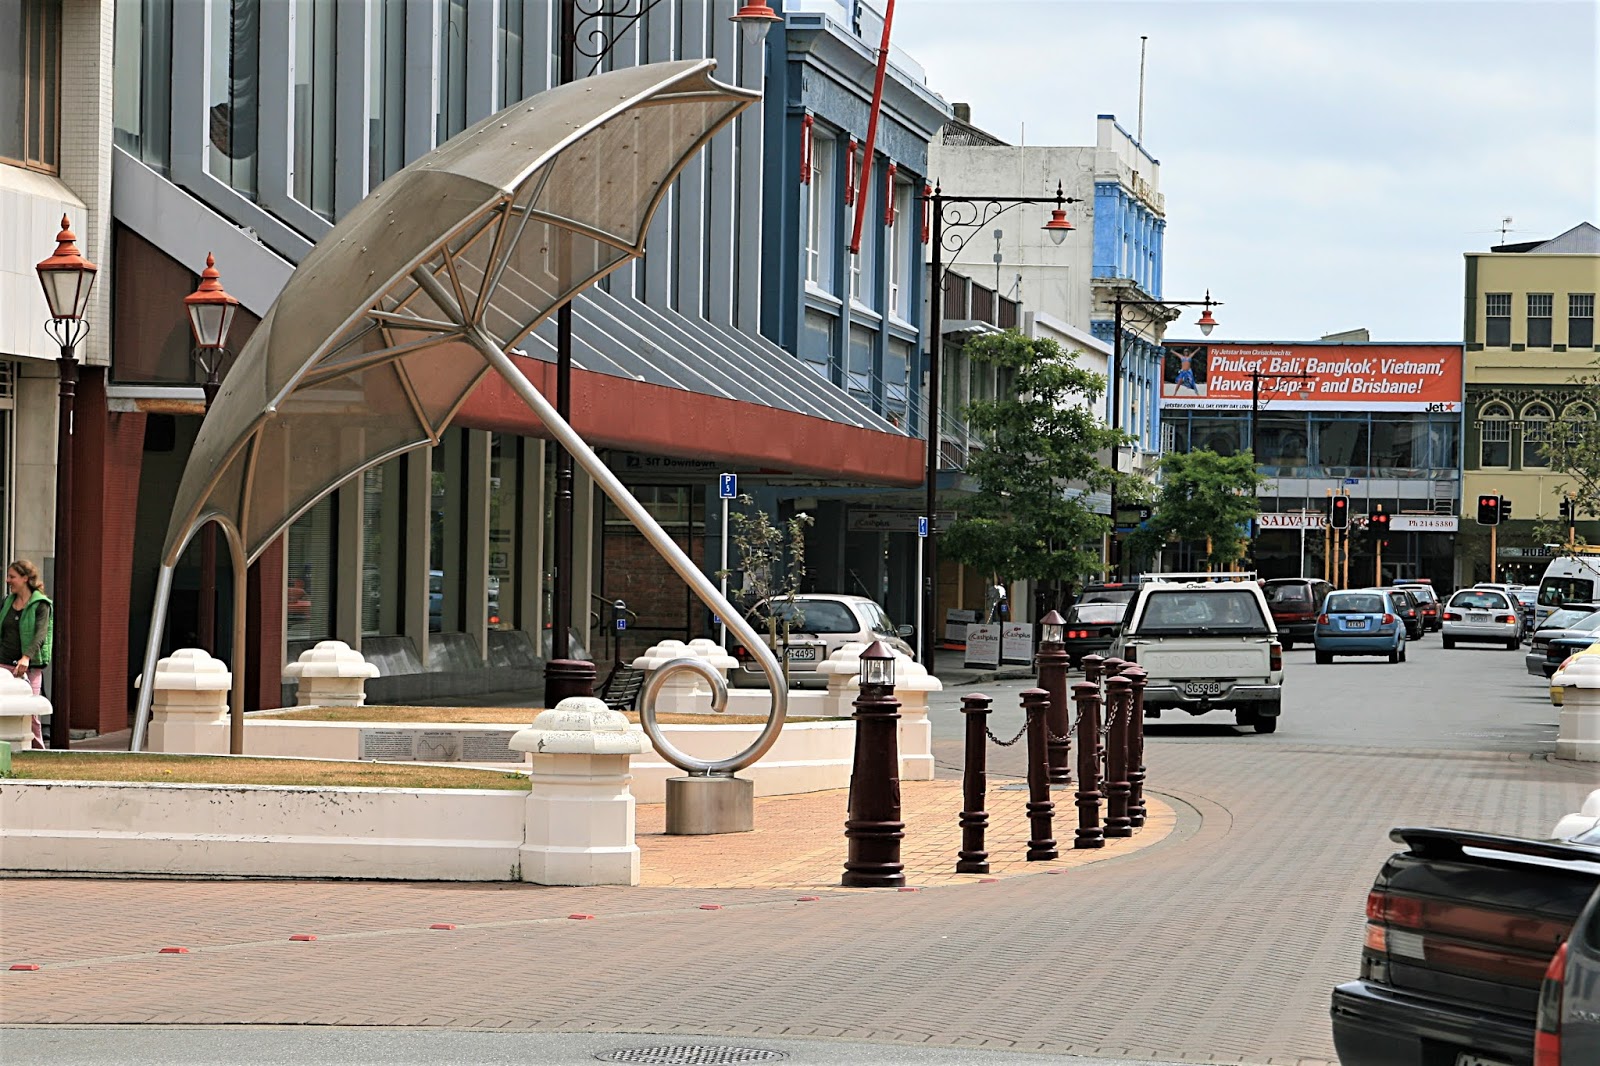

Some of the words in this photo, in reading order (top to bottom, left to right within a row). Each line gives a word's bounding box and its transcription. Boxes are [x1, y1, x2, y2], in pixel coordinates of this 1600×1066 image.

[1320, 377, 1349, 393] and
[1351, 377, 1424, 394] Brisbane!
[645, 457, 661, 466] SIT
[664, 457, 716, 468] Downtown
[1261, 515, 1330, 527] SALVATIO
[970, 633, 998, 642] Cashplus
[1005, 630, 1031, 639] Cashplus
[789, 648, 815, 659] 4495
[1153, 655, 1254, 670] TOYOTA
[1186, 682, 1220, 694] SG5988
